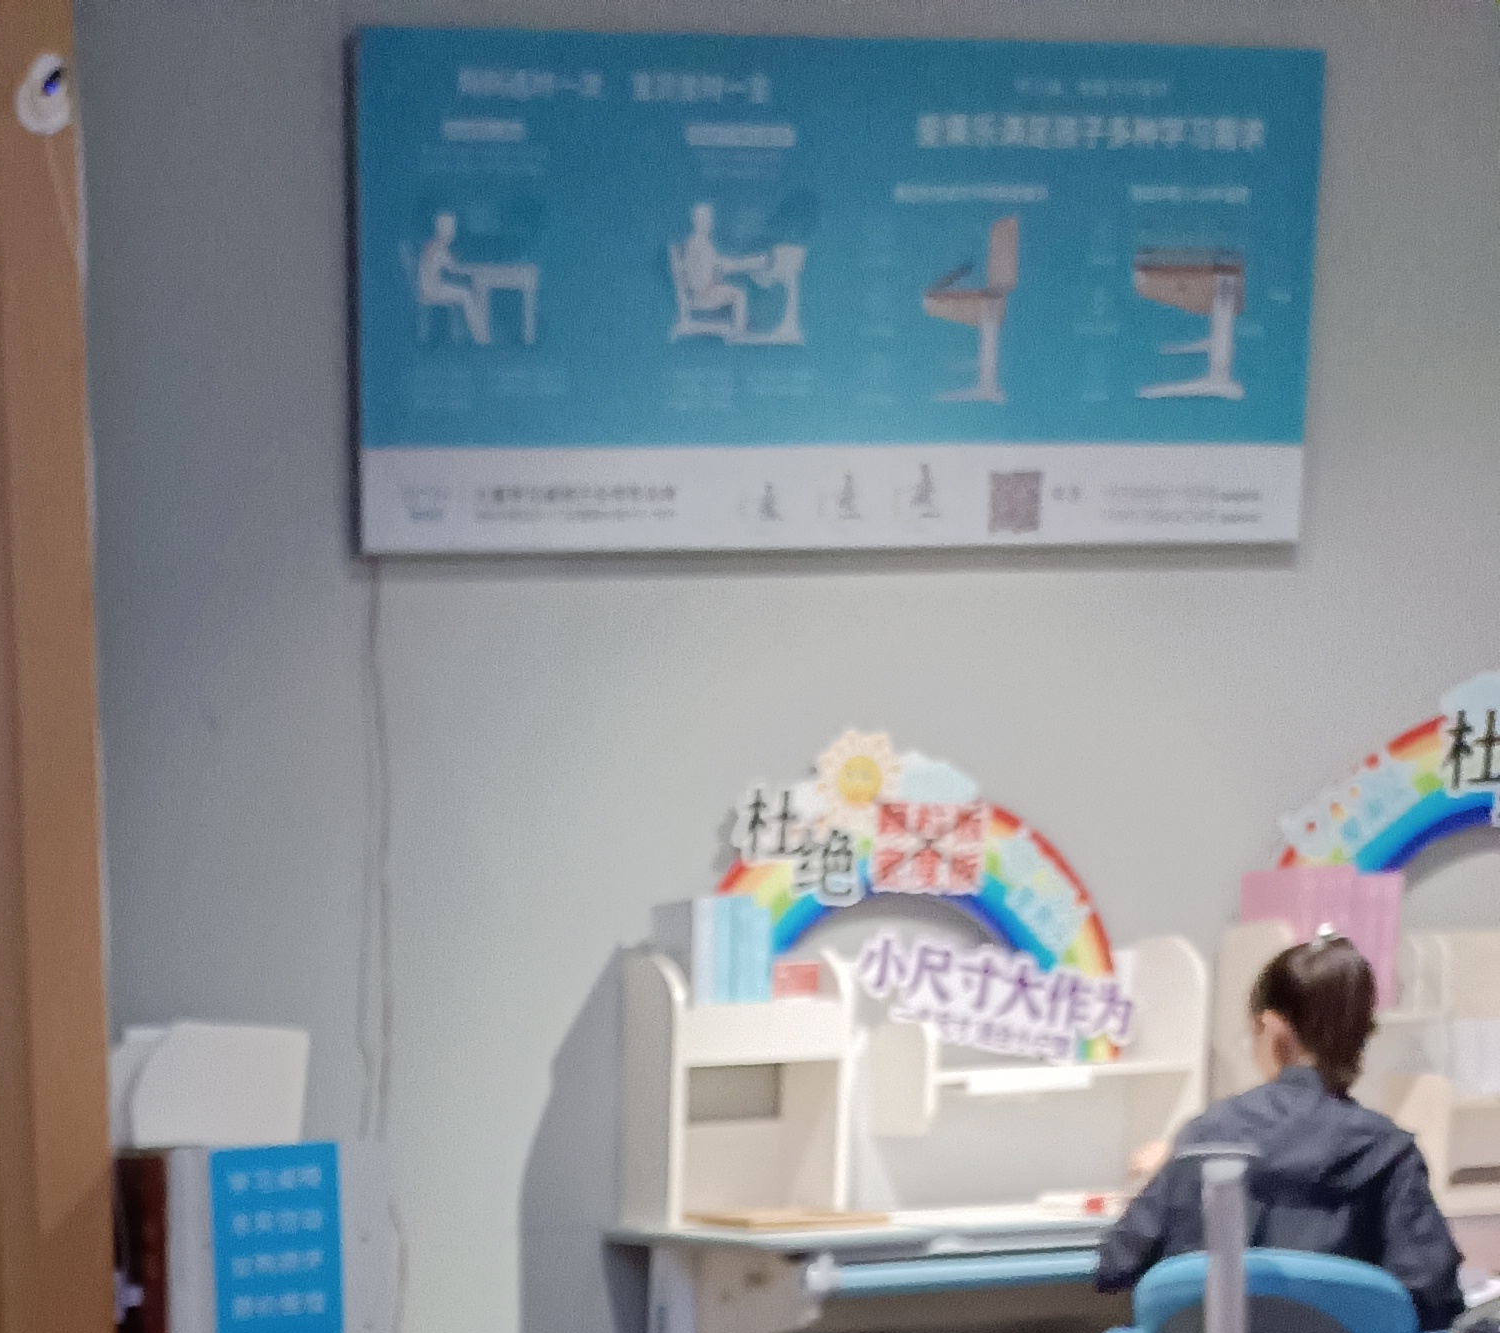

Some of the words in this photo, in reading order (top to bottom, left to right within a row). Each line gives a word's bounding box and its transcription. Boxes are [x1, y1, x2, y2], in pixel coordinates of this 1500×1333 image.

[857, 938, 1132, 1037] 小尺寸大作为
